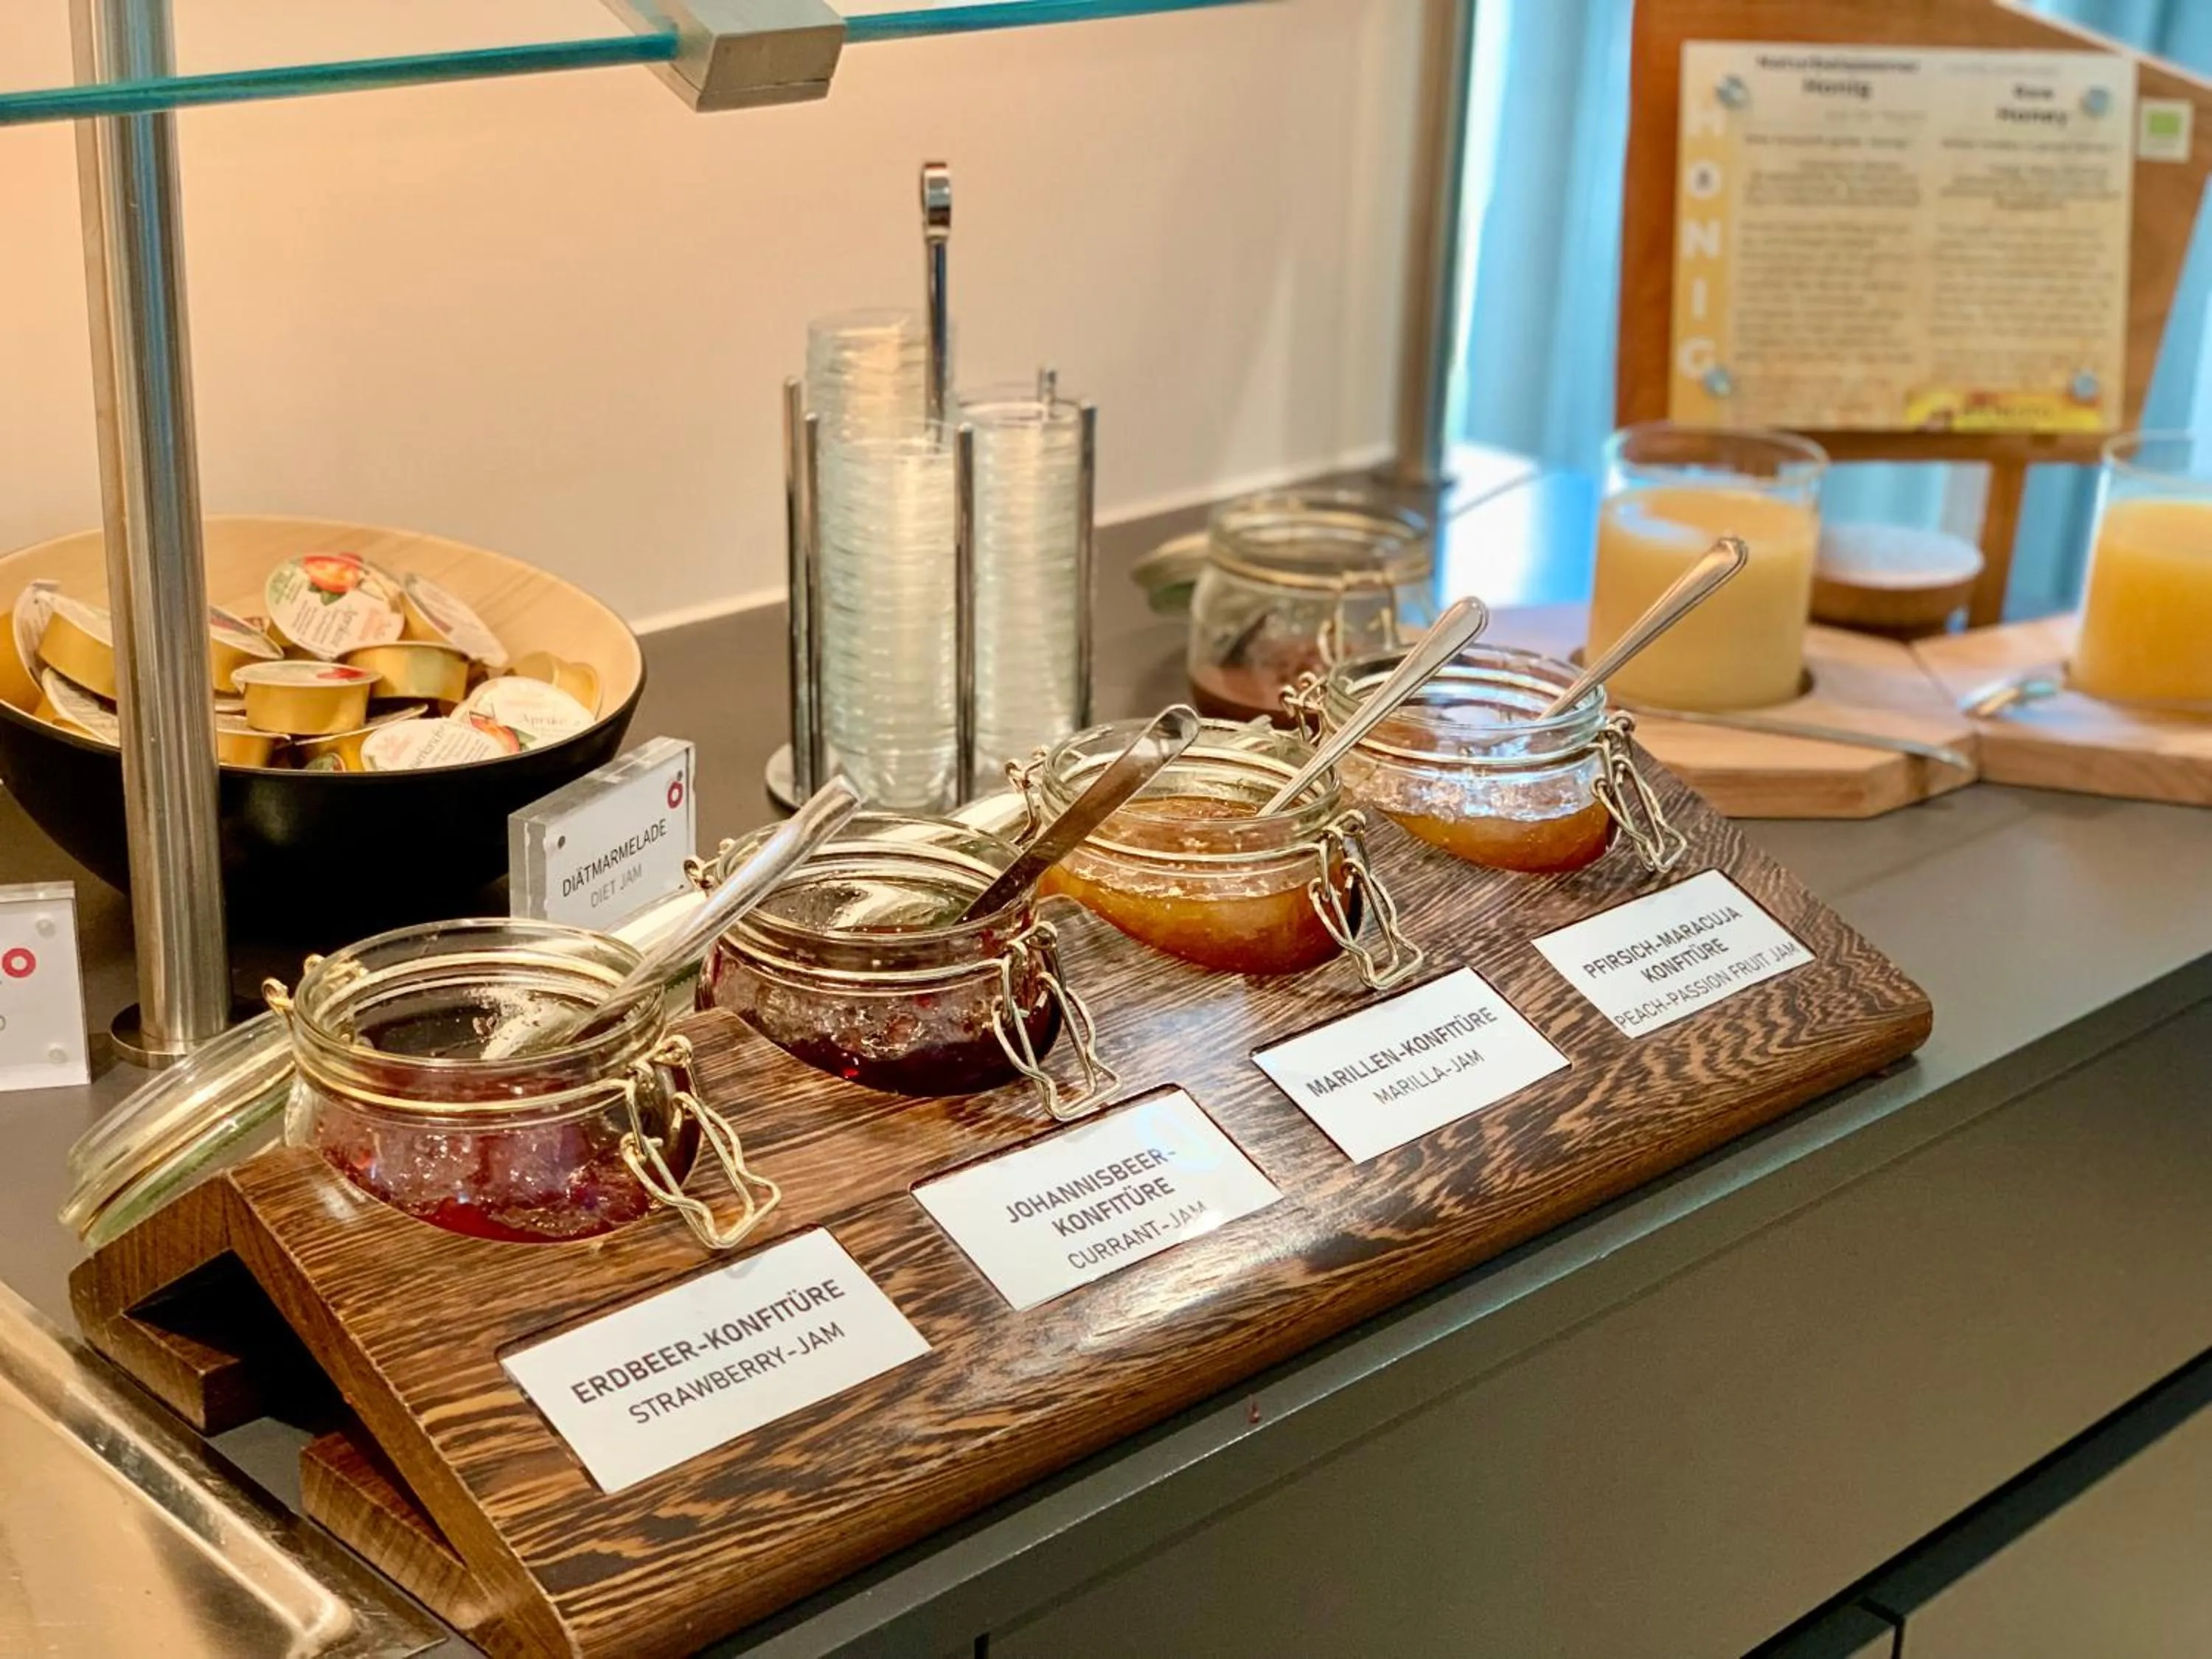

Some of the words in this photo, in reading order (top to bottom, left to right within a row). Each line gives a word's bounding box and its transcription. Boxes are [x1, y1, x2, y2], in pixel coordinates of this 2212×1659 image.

[562, 818, 667, 897] DIÄTMARMELADE
[591, 881, 616, 908] DIET
[619, 864, 642, 893] JAM
[1582, 906, 1742, 978] PFIRSICH-MARACUJA
[1641, 938, 1729, 982] KONFITÜRE
[1615, 970, 1732, 1029] PEACH-PASSION
[1731, 952, 1770, 978] FRUIT
[1774, 942, 1800, 962] JAM
[1307, 1006, 1498, 1098] MARILLEN-KONFITÜRE
[1373, 1050, 1484, 1105] MARILLA-JAM
[1005, 1148, 1177, 1222] JOHANNISBEER-
[1051, 1177, 1175, 1237] KONFITÜRE
[1068, 1201, 1208, 1270] CURRANT-JAM
[570, 1279, 844, 1404] ERDBEER-KONFITÜRE
[629, 1322, 845, 1425] STRAWBERRY-JAM
